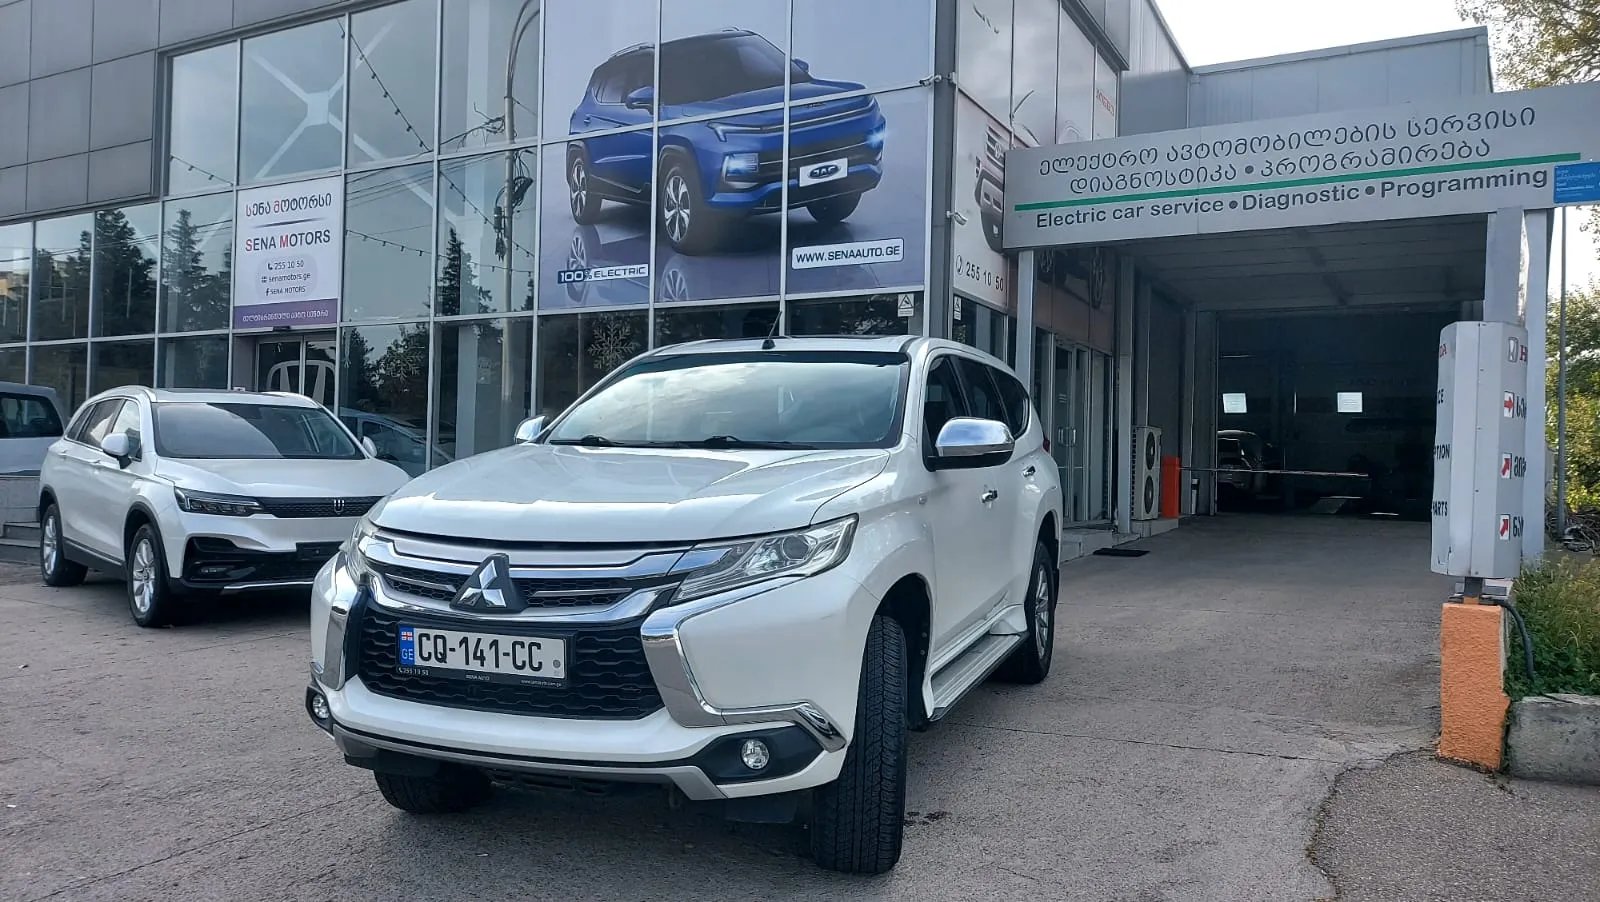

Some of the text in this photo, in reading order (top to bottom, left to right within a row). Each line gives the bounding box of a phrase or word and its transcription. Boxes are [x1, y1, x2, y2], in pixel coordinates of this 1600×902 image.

[1040, 107, 1536, 175] ელექტრო ავტომობილების სერვისი
[1070, 138, 1490, 194] დიაგნოსტიკა პროგრამირება
[245, 193, 332, 217] სენა მოტორსი
[1036, 209, 1107, 228] Electric
[1112, 204, 1144, 220] car
[1150, 196, 1224, 217] service
[1242, 184, 1360, 210] Diagnostic
[1381, 168, 1549, 199] Programming
[245, 229, 331, 252] SENA MOTORS
[796, 245, 901, 264] WWW.SENAAUTO.GE
[593, 266, 646, 278] ELECTRIC
[966, 261, 1004, 292] 255 10 50
[401, 648, 414, 661] GE
[418, 633, 543, 672] CQ-141-CC
